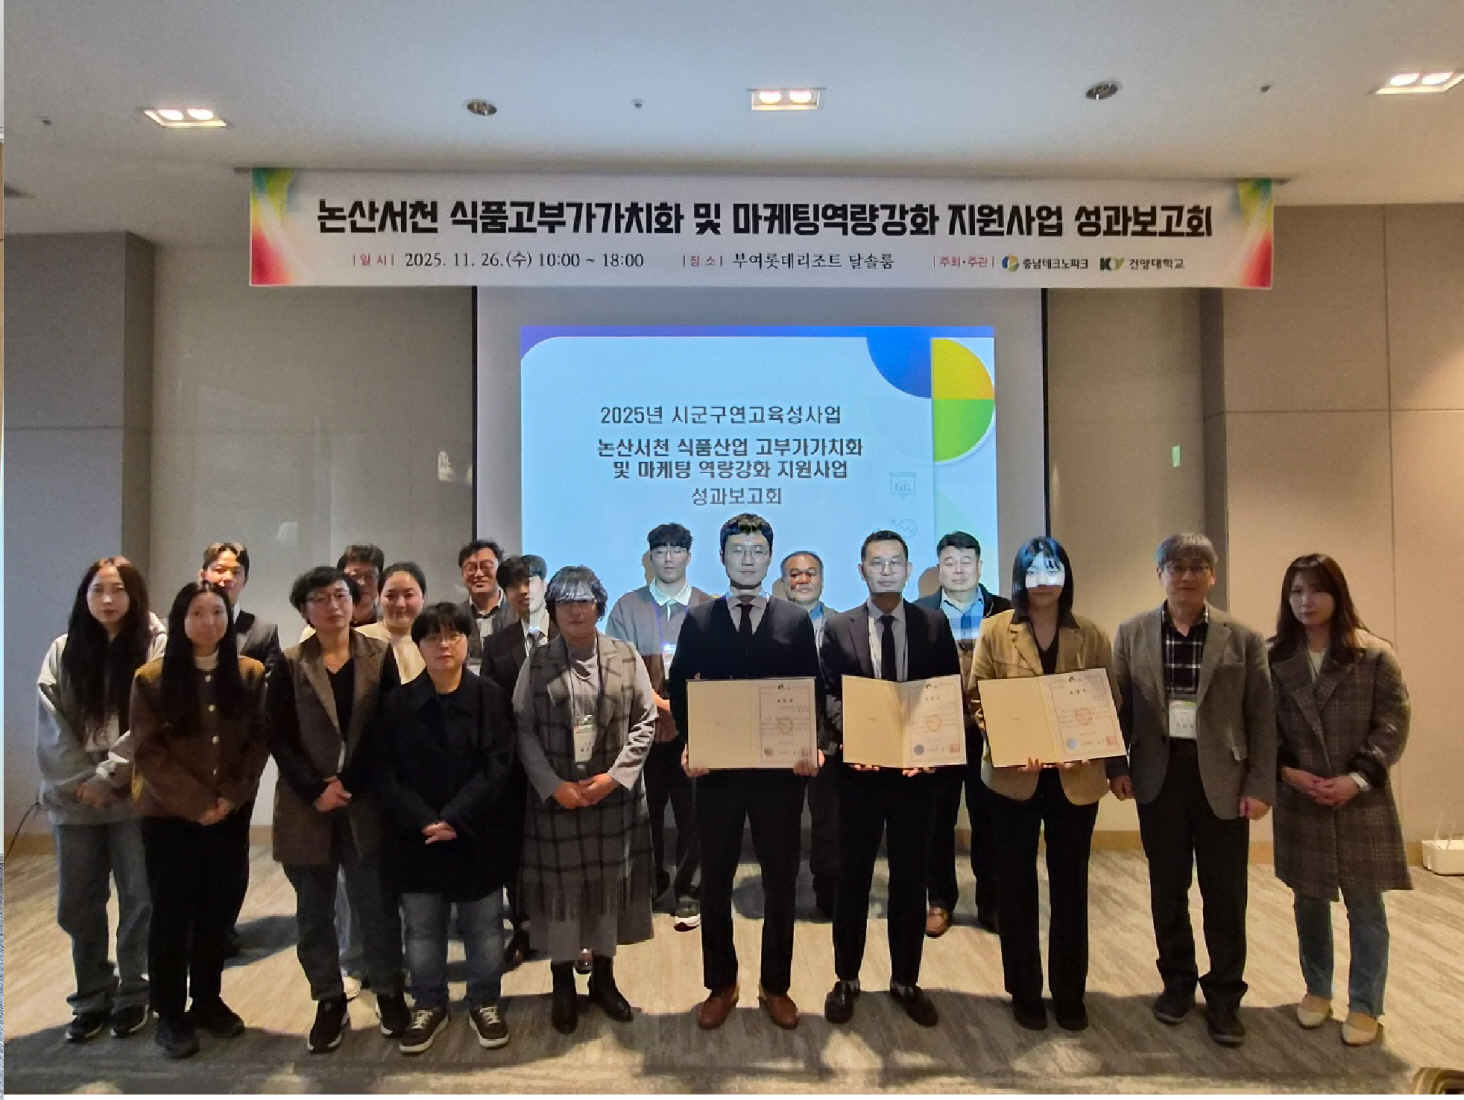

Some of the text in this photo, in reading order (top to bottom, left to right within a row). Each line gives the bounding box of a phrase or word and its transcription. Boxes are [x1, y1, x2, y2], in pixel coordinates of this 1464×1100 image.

[317, 198, 1213, 238] 논산서천 식품고부가가치화 및 마케팅역량강화 지원사업 성과보고회
[538, 252, 581, 268] 10:00
[601, 252, 644, 268] 18:00
[732, 252, 843, 270] 부여롯데리조트
[848, 252, 895, 270] 달솔룸
[1022, 257, 1089, 271] 충남테크노파크
[1129, 257, 1185, 270] 건양대학교
[600, 405, 841, 425] 2025년 시군구연고육성사업
[597, 437, 864, 458] 논산서천 식품산업 고부가가치화
[612, 460, 848, 479] 및 마케팅 역량강화 지원사업
[691, 487, 783, 506] 성과보고회
